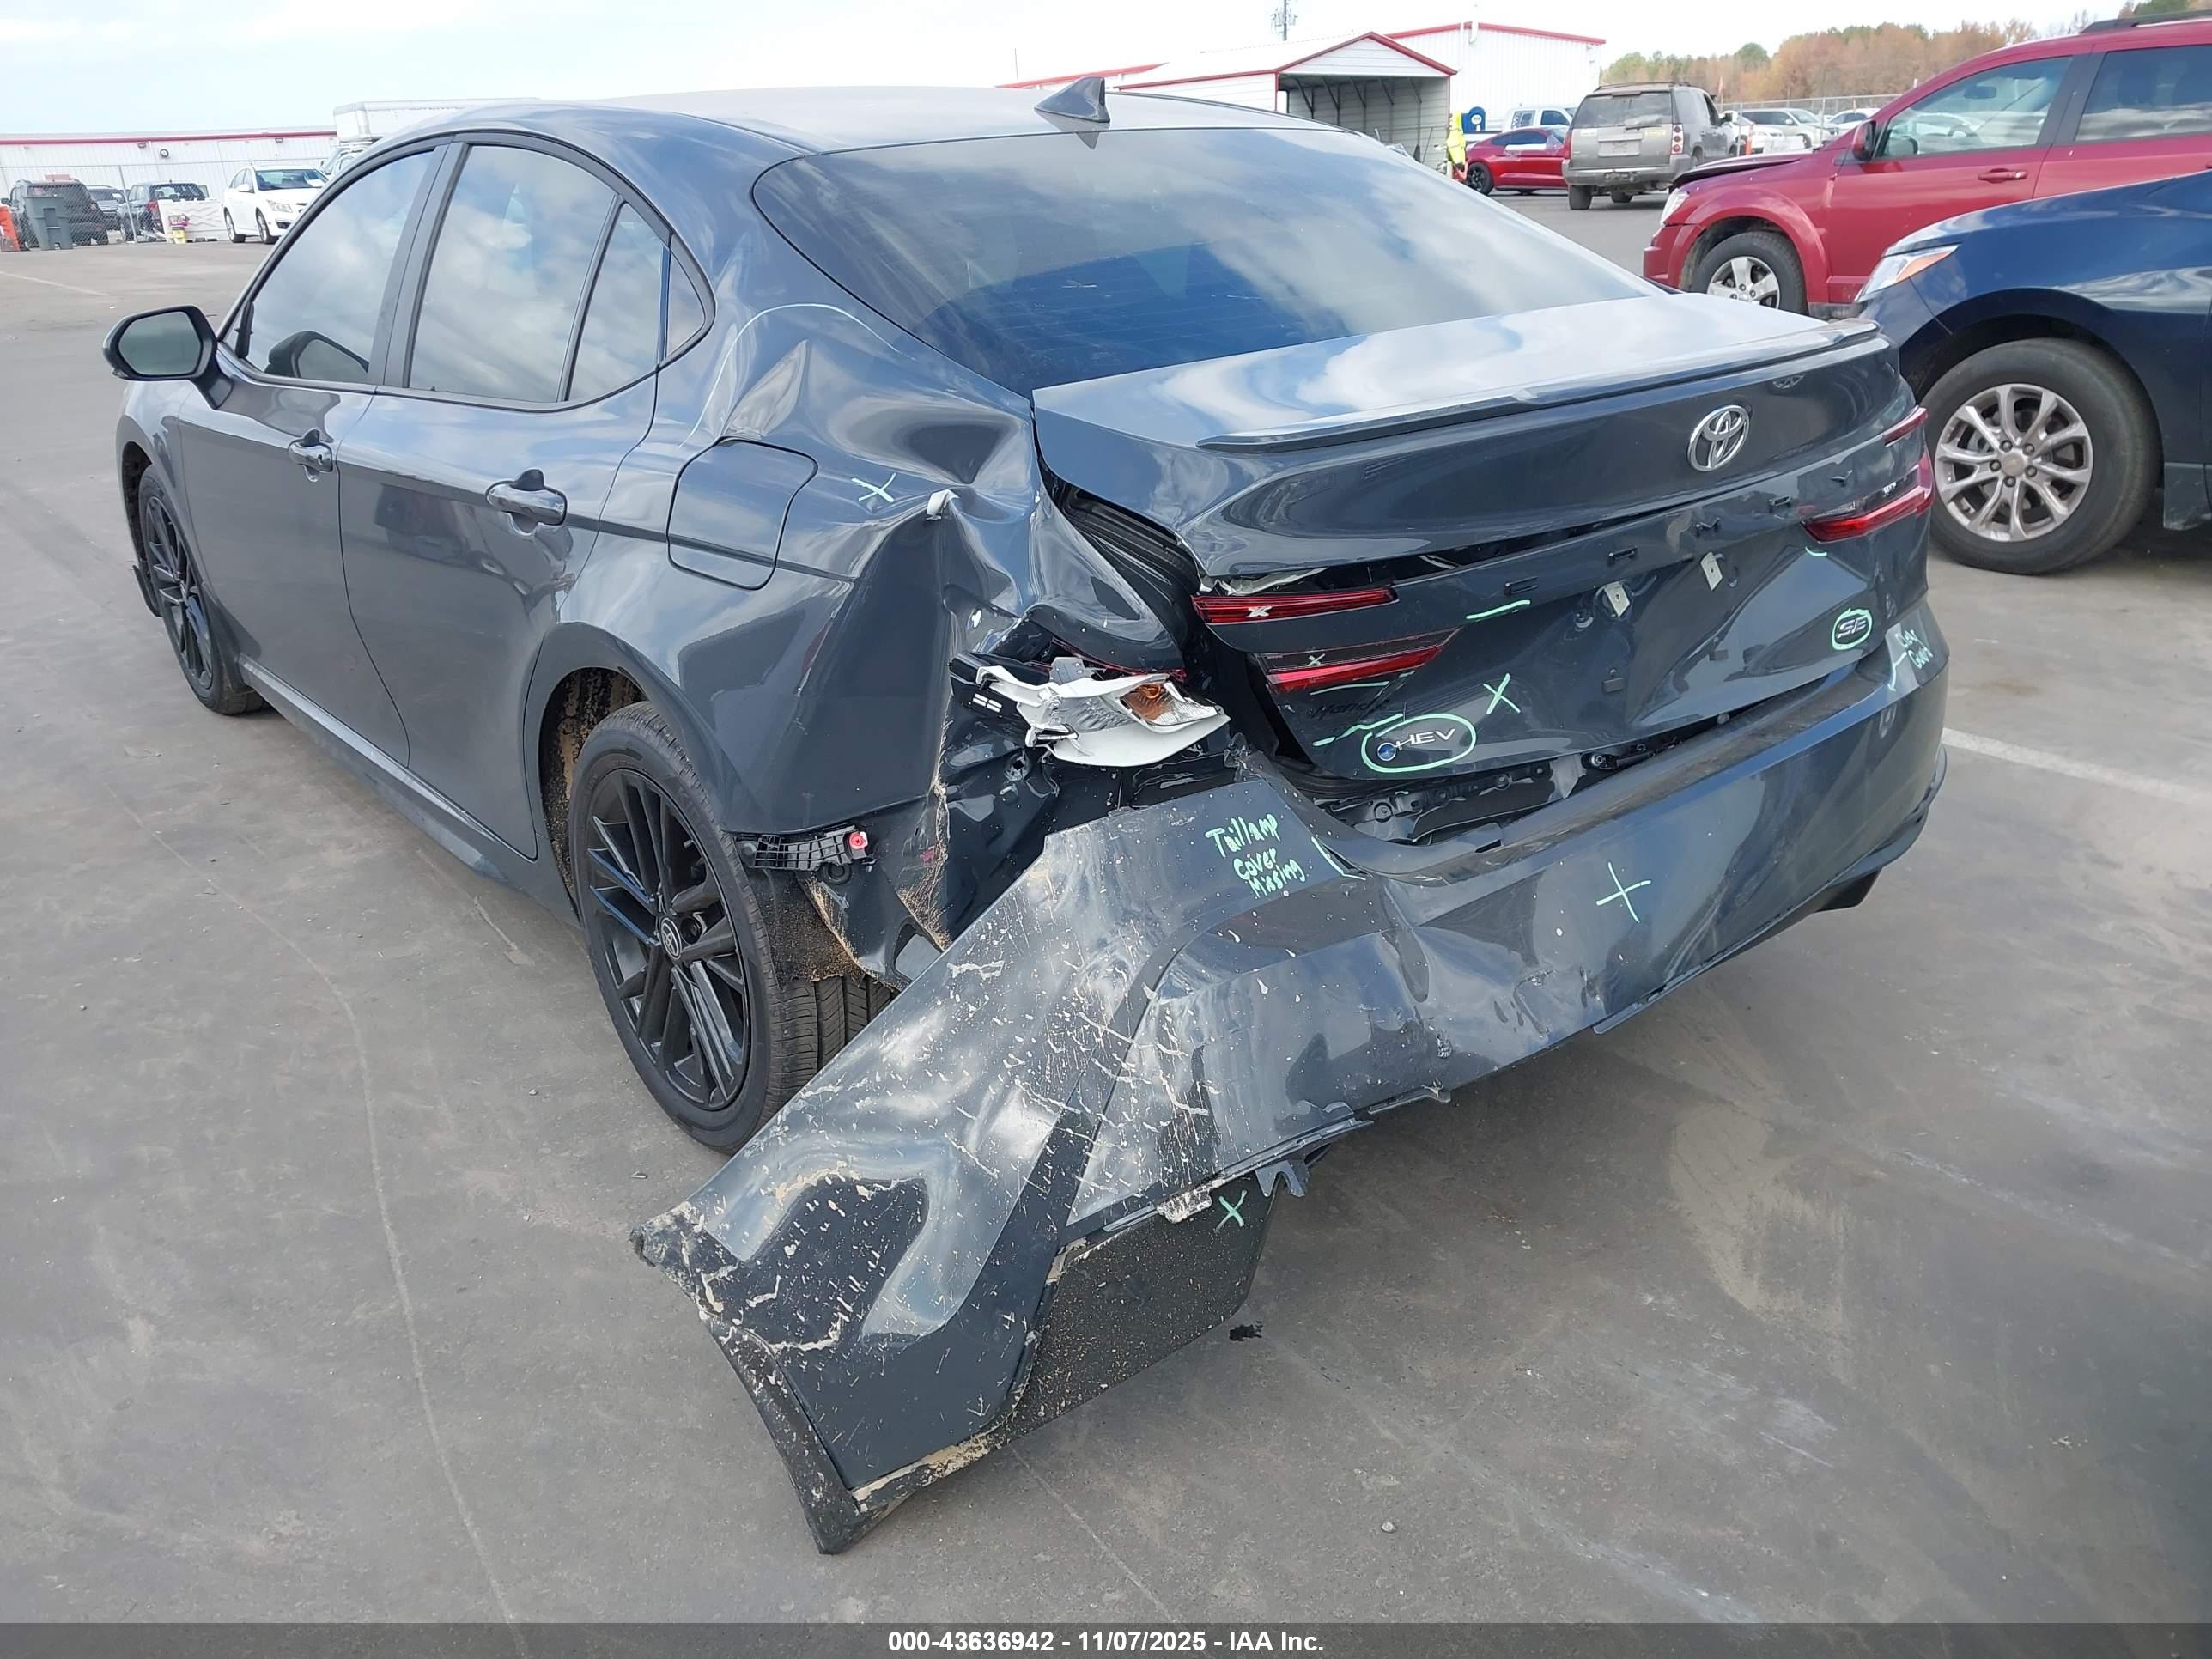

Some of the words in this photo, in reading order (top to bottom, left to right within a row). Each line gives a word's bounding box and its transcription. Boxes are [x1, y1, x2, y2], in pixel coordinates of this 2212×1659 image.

[1837, 617, 1868, 639] SE
[1395, 727, 1455, 751] HEV
[1233, 848, 1277, 880] Cover
[1249, 859, 1306, 898] Missing
